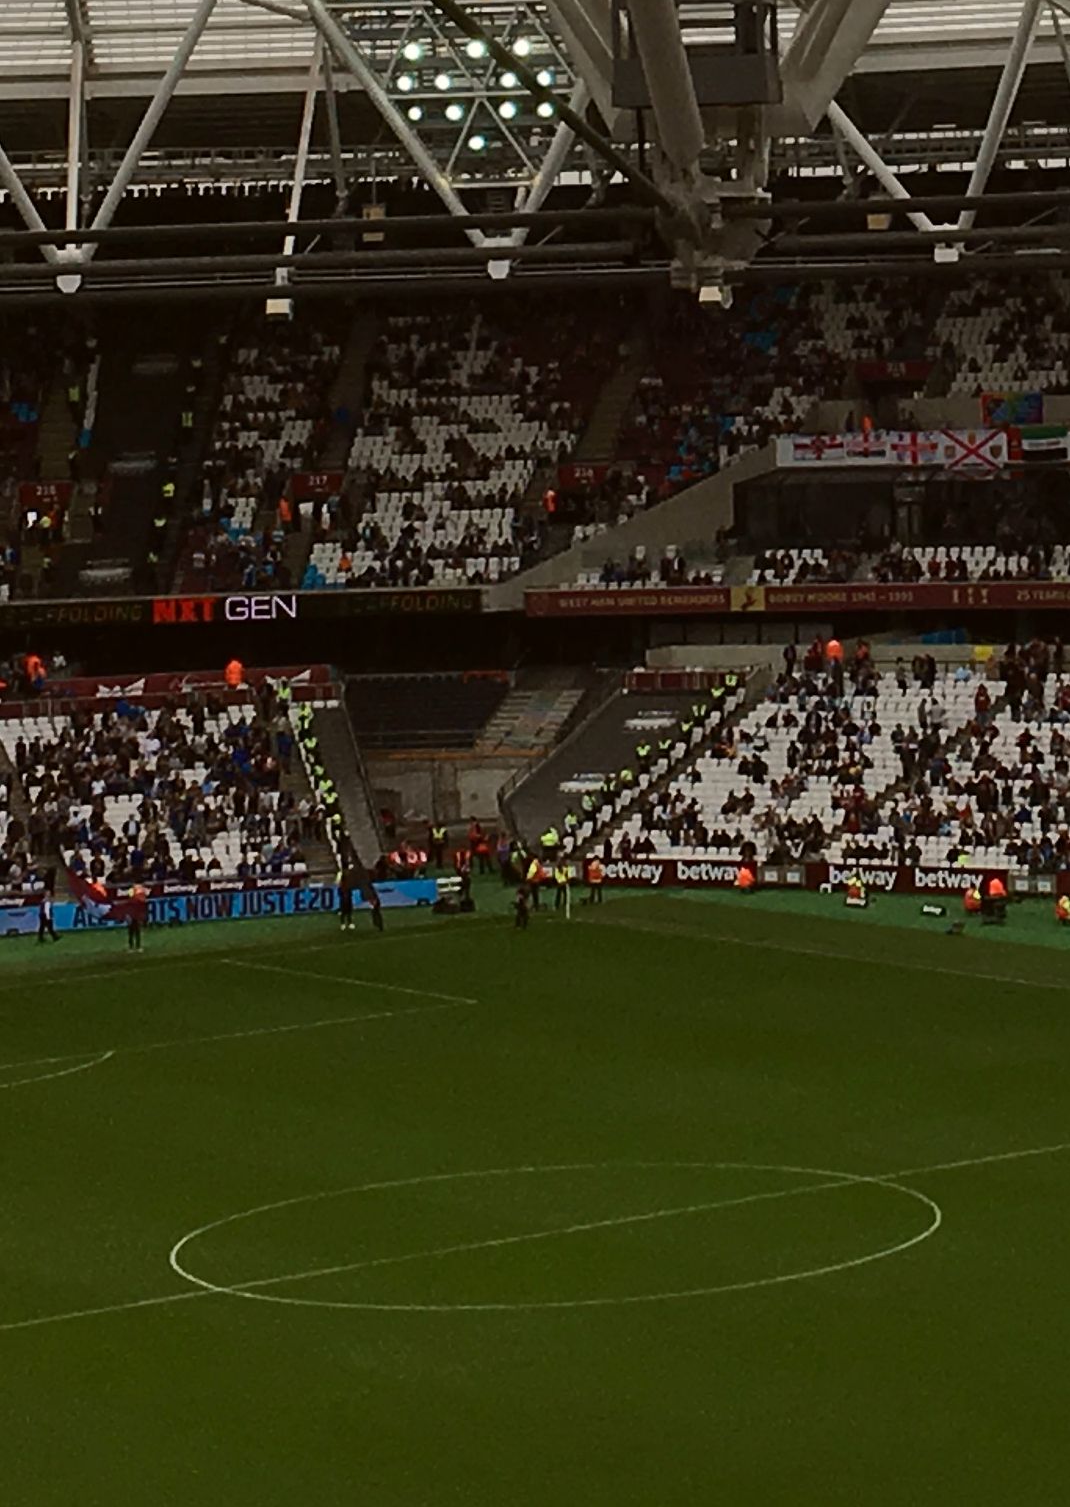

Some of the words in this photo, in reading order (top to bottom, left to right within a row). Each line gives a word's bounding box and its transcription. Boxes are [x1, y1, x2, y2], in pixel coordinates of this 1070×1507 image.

[224, 595, 297, 621] GEN
[914, 867, 984, 891] betway
[186, 892, 234, 921] NOW
[239, 888, 287, 917] JUST
